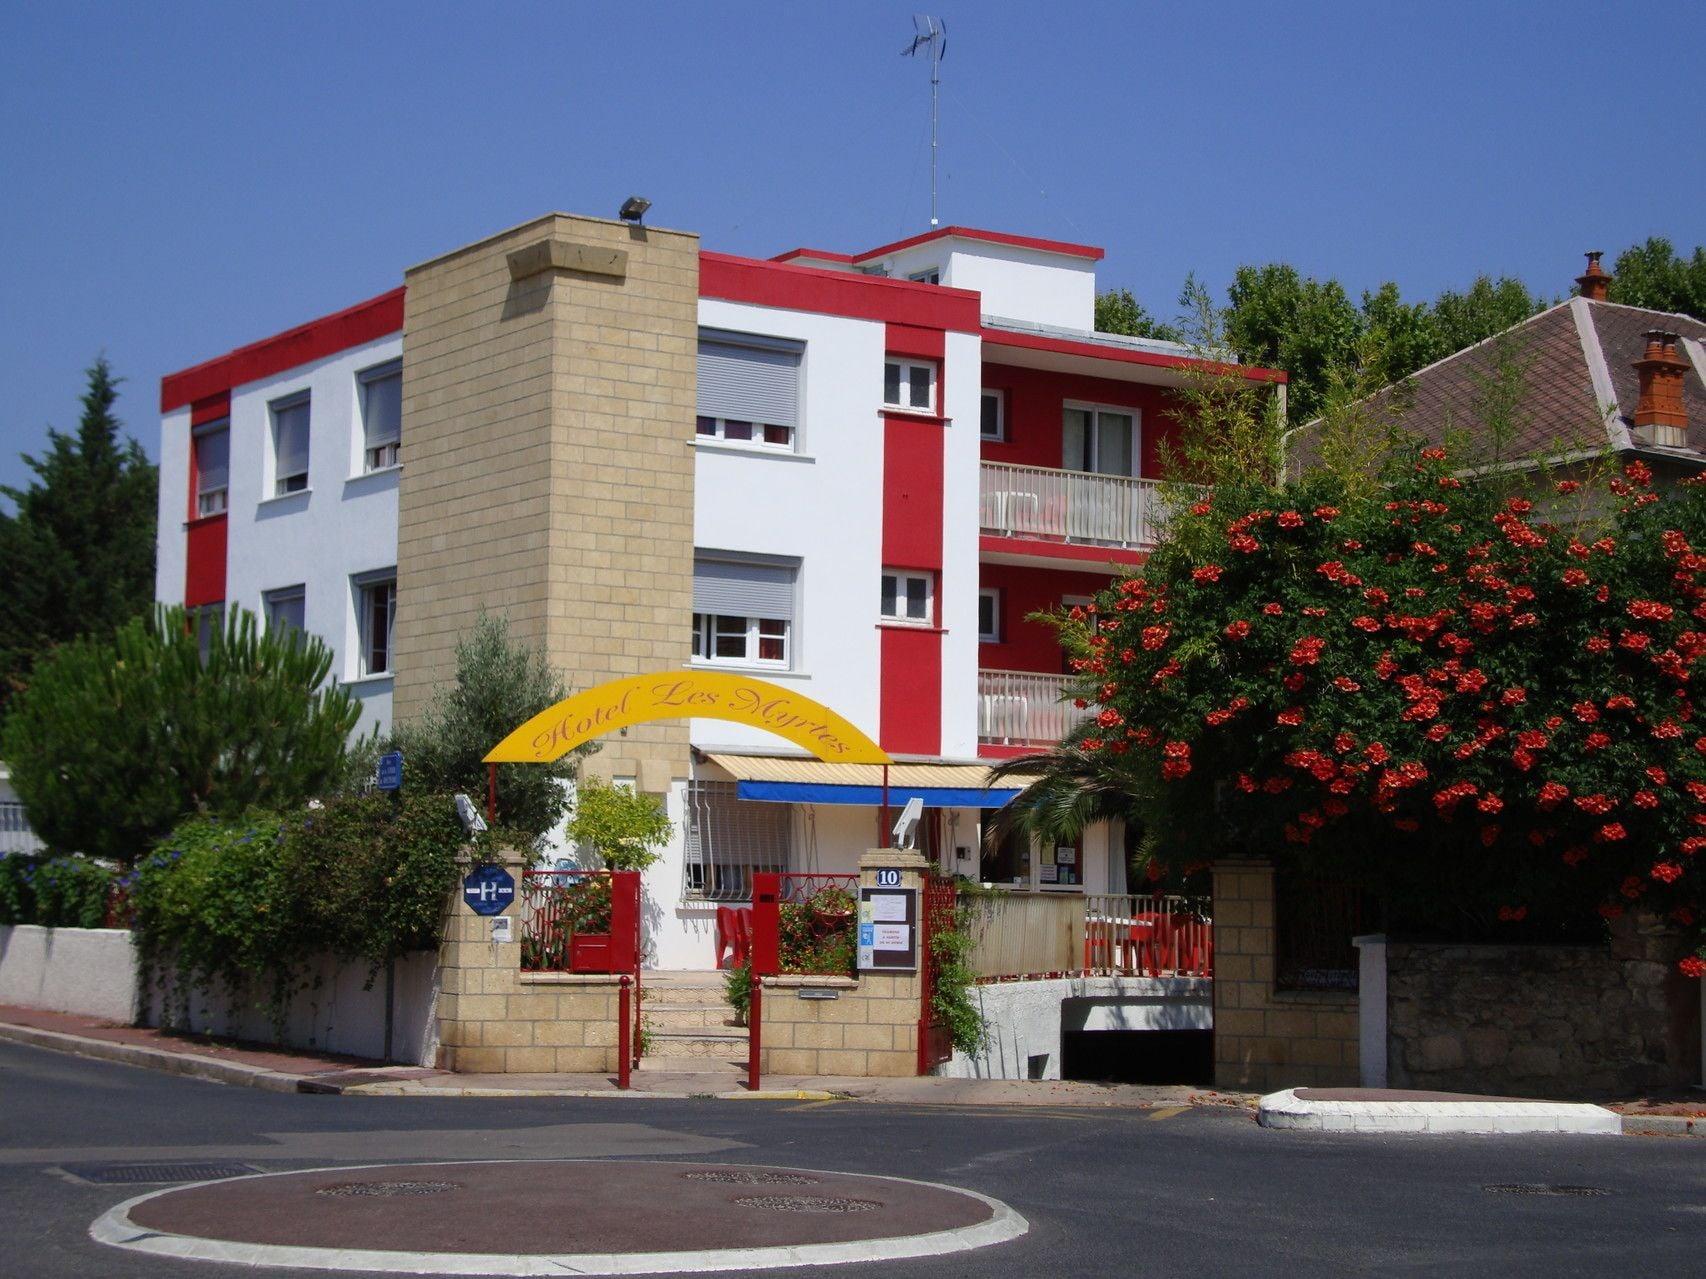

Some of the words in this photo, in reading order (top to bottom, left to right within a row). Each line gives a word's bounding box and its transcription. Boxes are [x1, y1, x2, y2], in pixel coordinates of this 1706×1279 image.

[532, 686, 640, 758] Hotel
[651, 680, 720, 706] Les
[728, 687, 850, 754] Myrtes
[880, 870, 898, 885] 10
[480, 881, 497, 901] H
